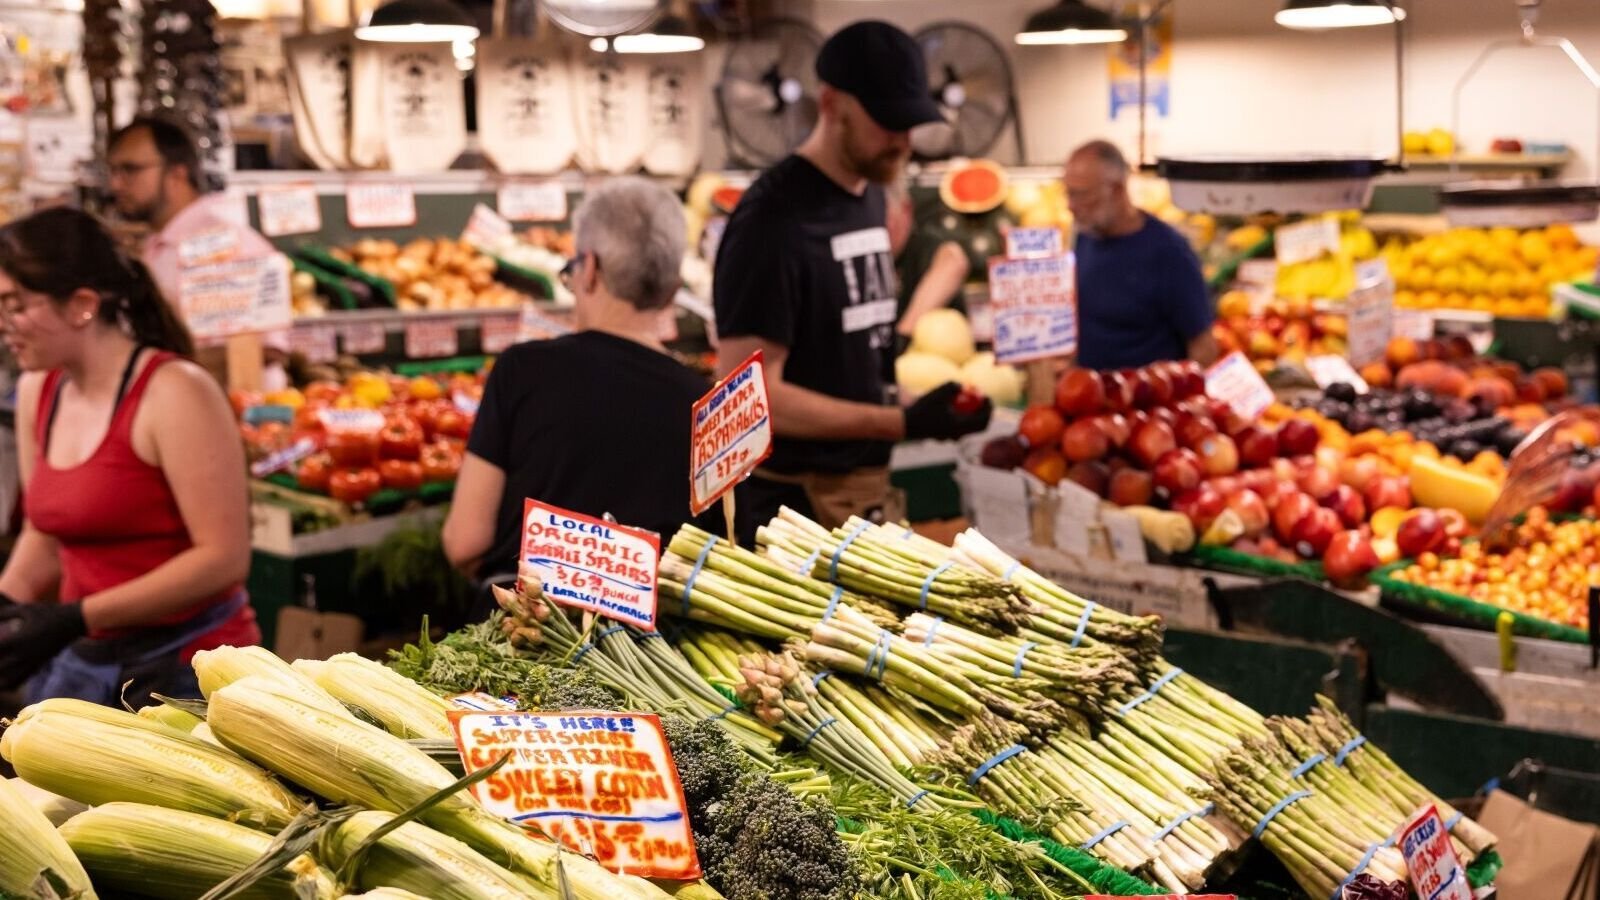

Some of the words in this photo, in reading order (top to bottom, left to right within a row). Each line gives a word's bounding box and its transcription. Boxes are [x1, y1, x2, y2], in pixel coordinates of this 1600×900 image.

[697, 397, 764, 468] ASPARAGUS
[549, 514, 615, 540] LOCAL
[527, 522, 645, 564] ORGANIC
[585, 551, 652, 584] SPEARS
[602, 586, 640, 604] BUNCH
[489, 714, 547, 729] IT'S
[568, 748, 657, 772] RIVER
[486, 768, 584, 801] SWEET
[595, 770, 669, 800] CORN
